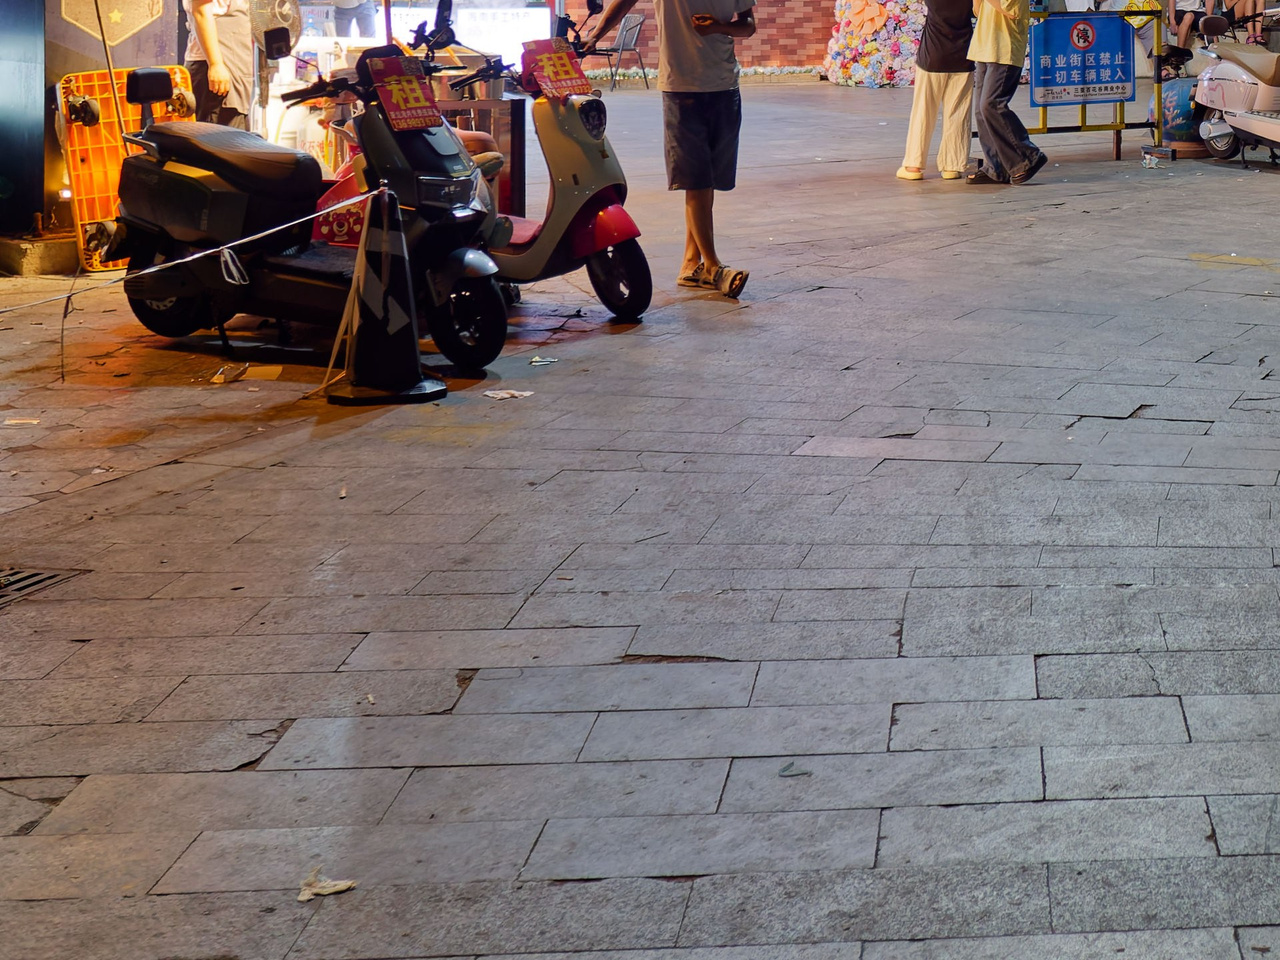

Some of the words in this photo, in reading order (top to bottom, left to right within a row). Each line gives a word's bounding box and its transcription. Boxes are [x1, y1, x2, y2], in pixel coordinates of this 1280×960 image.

[536, 52, 579, 81] 租
[1040, 51, 1125, 69] 商业街区禁止
[1040, 68, 1126, 84] 一切车辆驶入
[384, 74, 431, 109] 租
